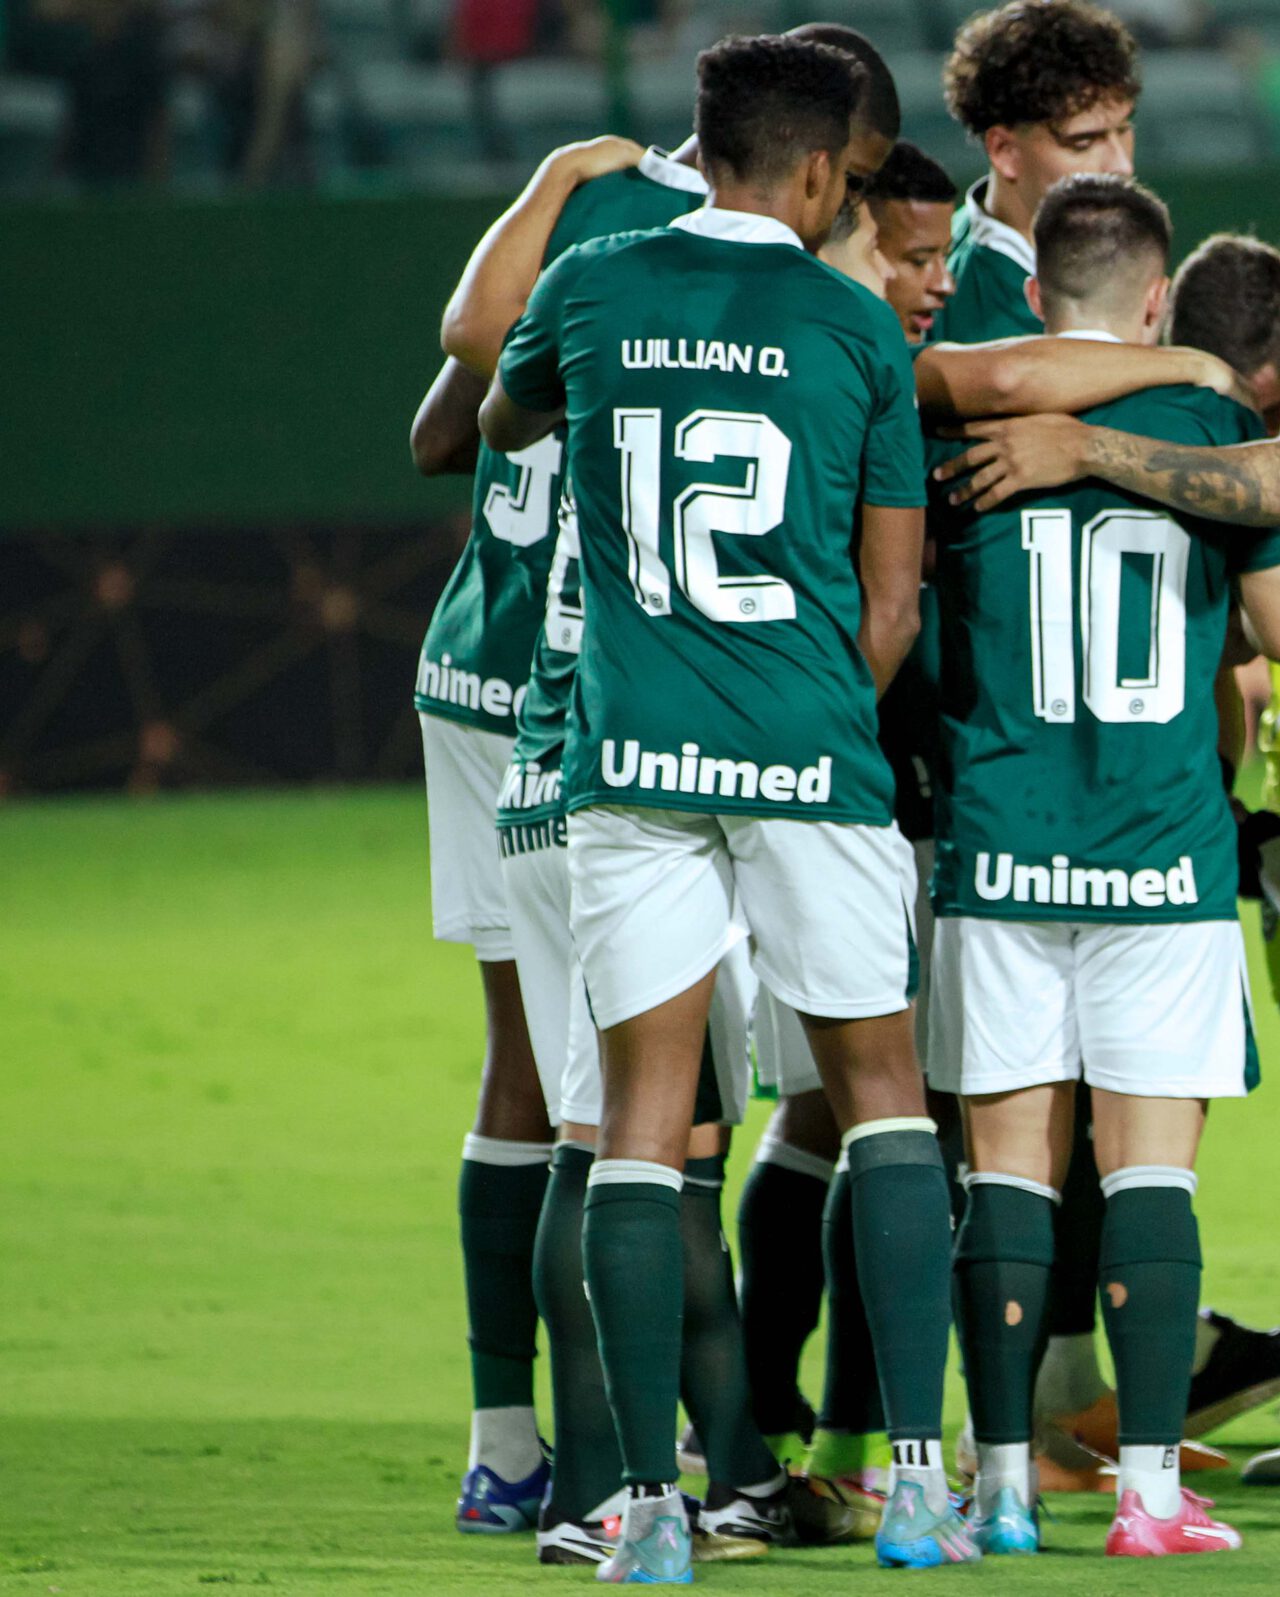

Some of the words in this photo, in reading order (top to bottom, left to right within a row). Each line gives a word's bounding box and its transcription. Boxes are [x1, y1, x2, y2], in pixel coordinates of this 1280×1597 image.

[621, 339, 752, 373] WILLIAN
[758, 346, 790, 378] O.
[612, 407, 797, 623] 12
[1020, 508, 1191, 724] 10
[415, 648, 529, 718] nime
[601, 738, 832, 804] Unimed
[974, 851, 1199, 907] Unimed
